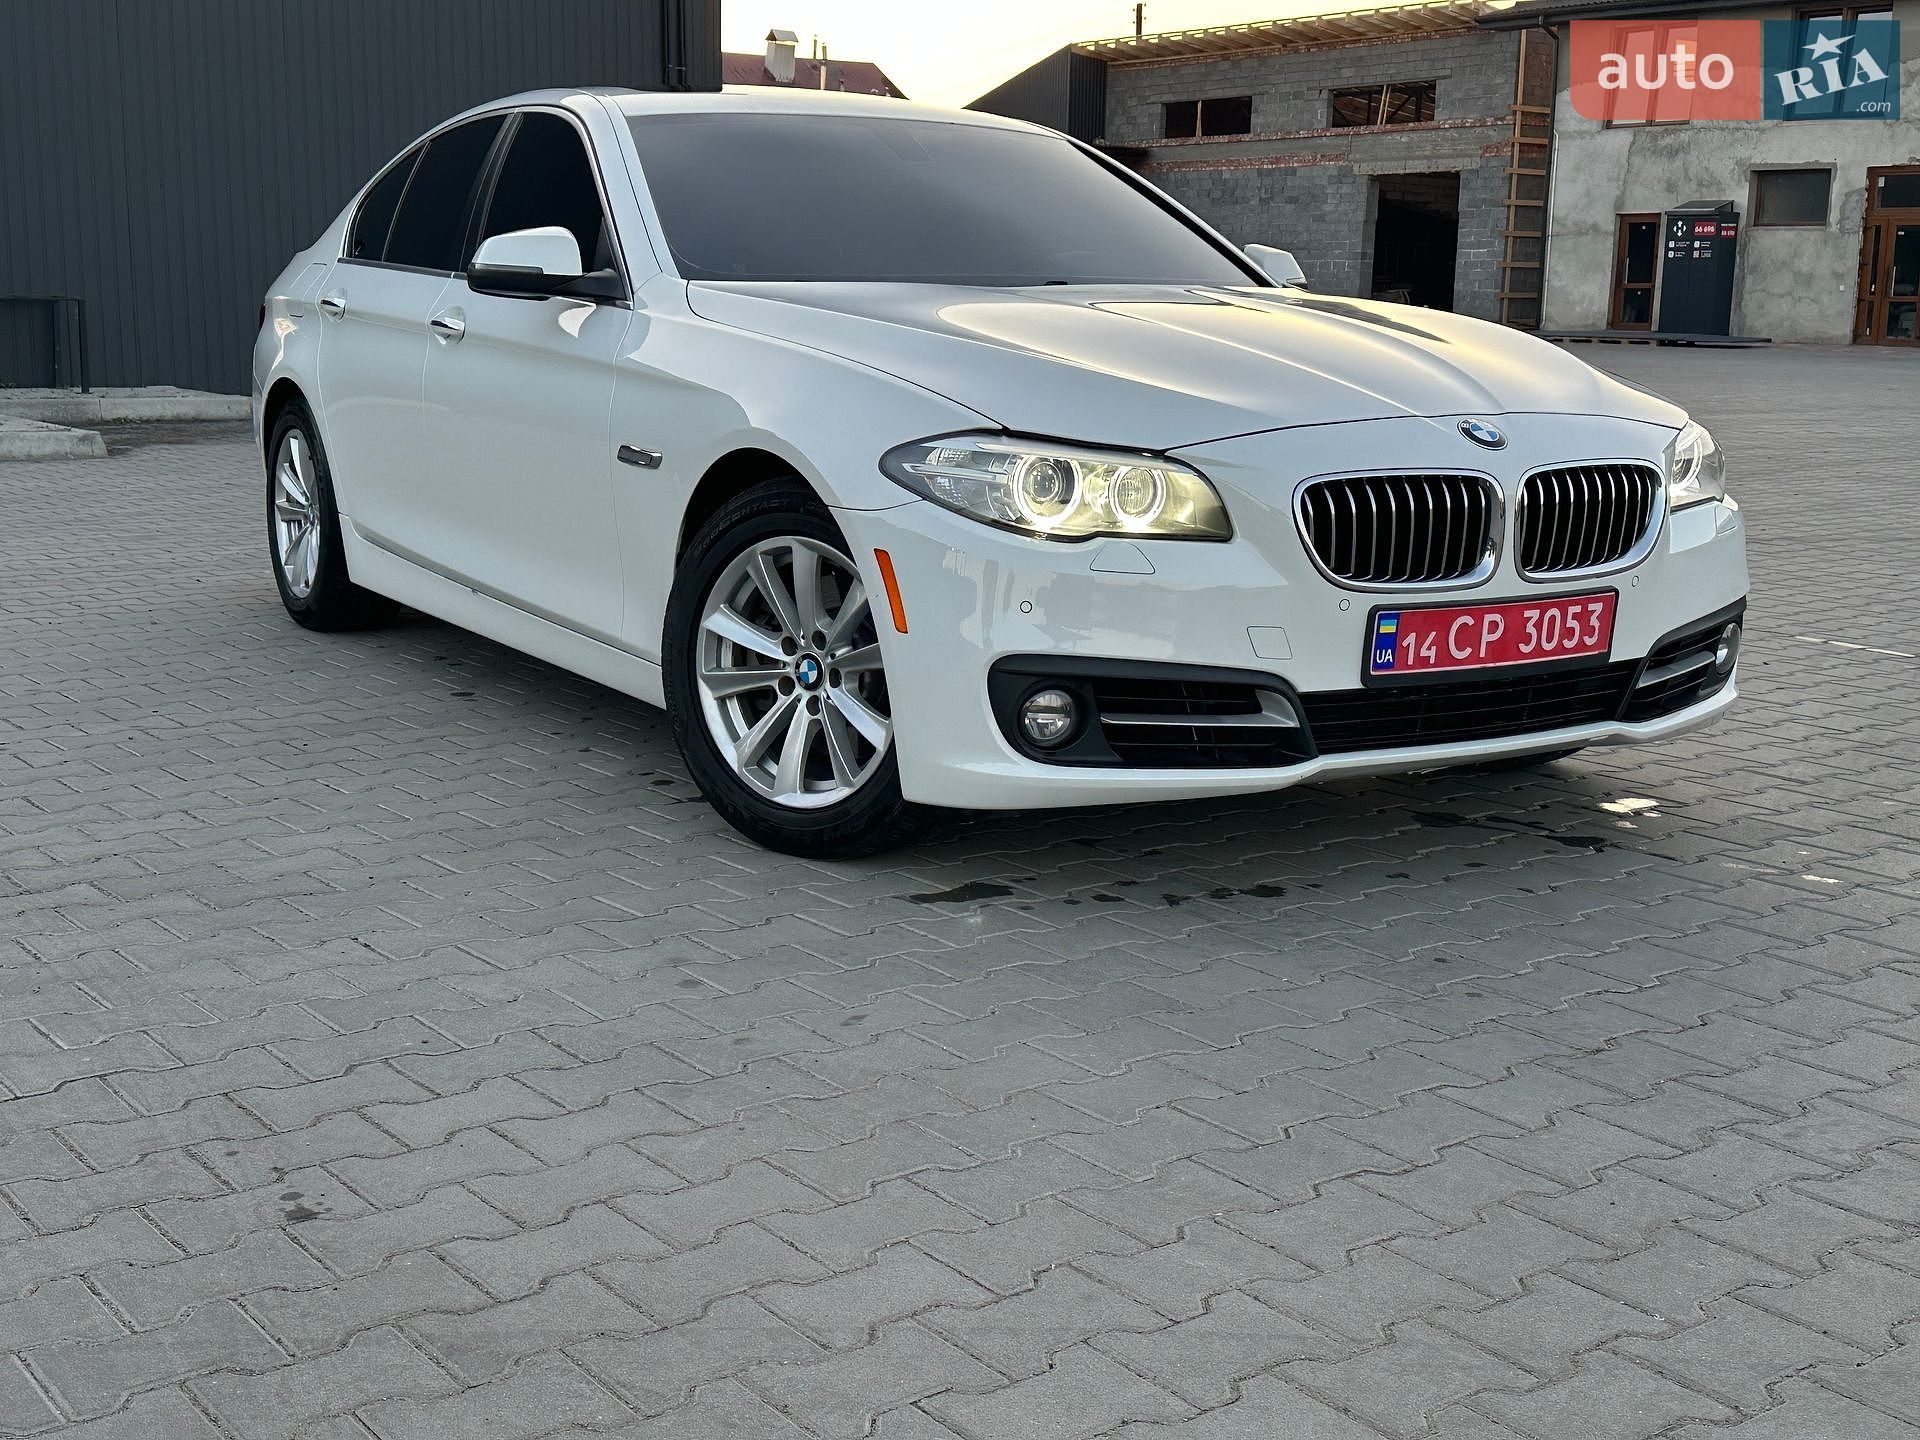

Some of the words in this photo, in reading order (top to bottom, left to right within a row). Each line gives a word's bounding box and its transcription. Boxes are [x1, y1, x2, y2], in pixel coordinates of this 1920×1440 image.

[1401, 631, 1437, 665] 14
[1448, 613, 1505, 660] CP
[1518, 602, 1603, 654] 3053
[1376, 649, 1393, 664] UA
